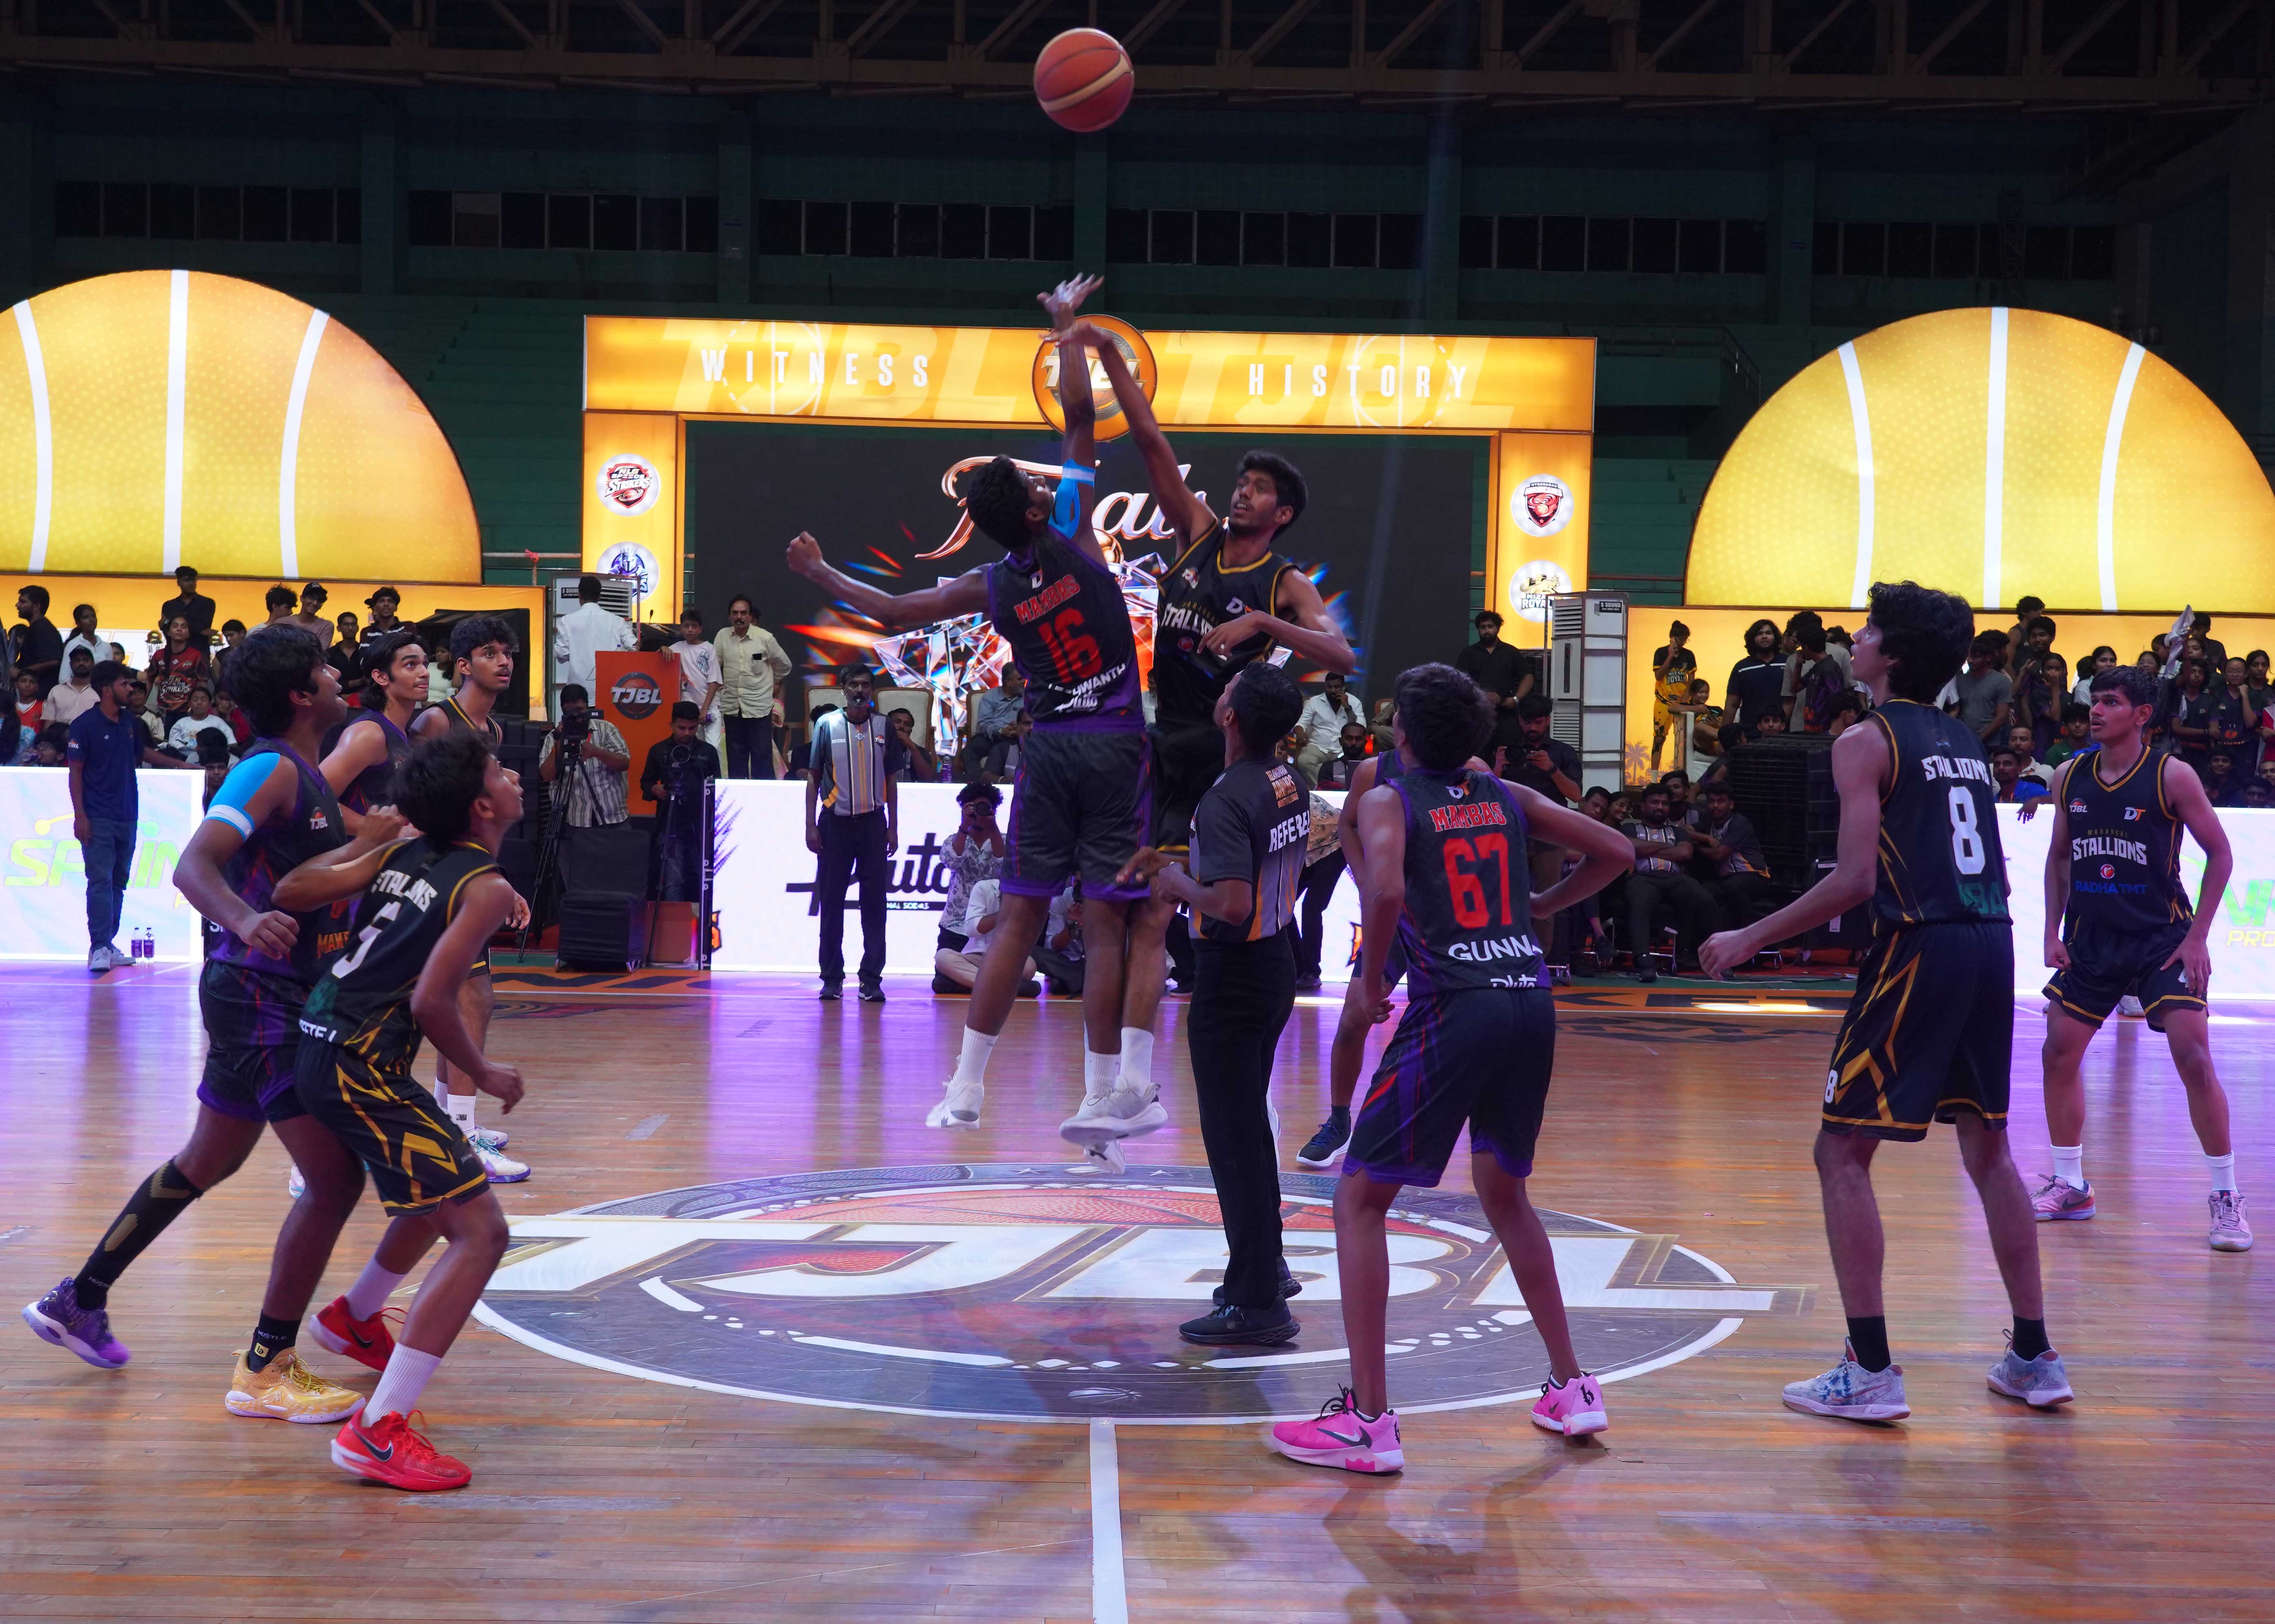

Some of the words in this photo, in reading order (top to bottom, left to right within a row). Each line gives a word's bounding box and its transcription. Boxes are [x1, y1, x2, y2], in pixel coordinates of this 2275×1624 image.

[701, 349, 928, 387] WITNESS
[1041, 356, 1148, 390] TBL
[1249, 363, 1467, 397] HISTORY
[1013, 574, 1081, 625] MAMBAS
[1522, 599, 1553, 609] ROYAL
[1038, 608, 1103, 685] 16
[611, 687, 662, 704] TJBL
[1429, 802, 1507, 832] MAMBAS
[2070, 805, 2088, 813] TJBL
[2124, 806, 2146, 821] DT
[1949, 786, 1986, 875] 8
[2072, 837, 2147, 865] STALLIONS
[1443, 833, 1512, 929] 67
[2075, 880, 2118, 894] RADHA
[2119, 883, 2147, 894] TMT
[483, 1216, 1786, 1313] TJBL
